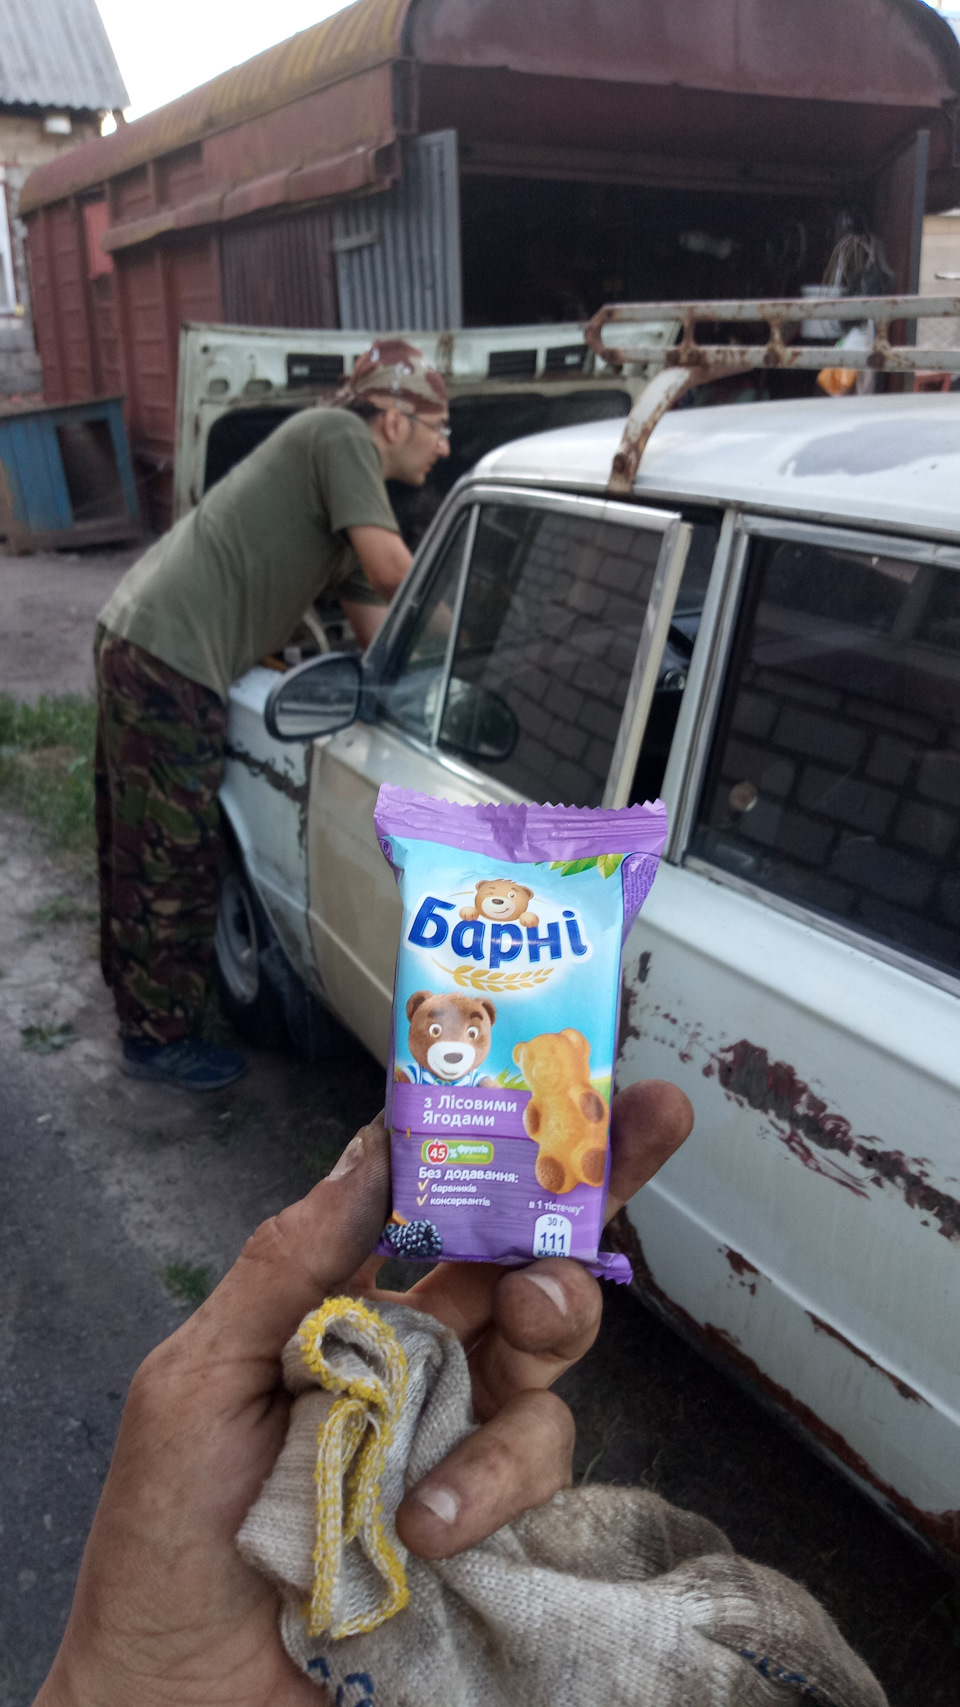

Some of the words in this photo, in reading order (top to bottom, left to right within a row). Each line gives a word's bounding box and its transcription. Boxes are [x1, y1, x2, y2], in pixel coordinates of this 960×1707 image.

[407, 896, 587, 969] Барні
[438, 1095, 517, 1112] Лісовими
[423, 1111, 495, 1127] Ягодами
[419, 1167, 441, 1178] Без
[444, 1168, 519, 1183] додавання:
[431, 1184, 476, 1194] барвників
[430, 1197, 490, 1206] консервантів
[537, 1200, 542, 1209] 1
[547, 1217, 557, 1226] 30
[540, 1232, 565, 1250] 111
